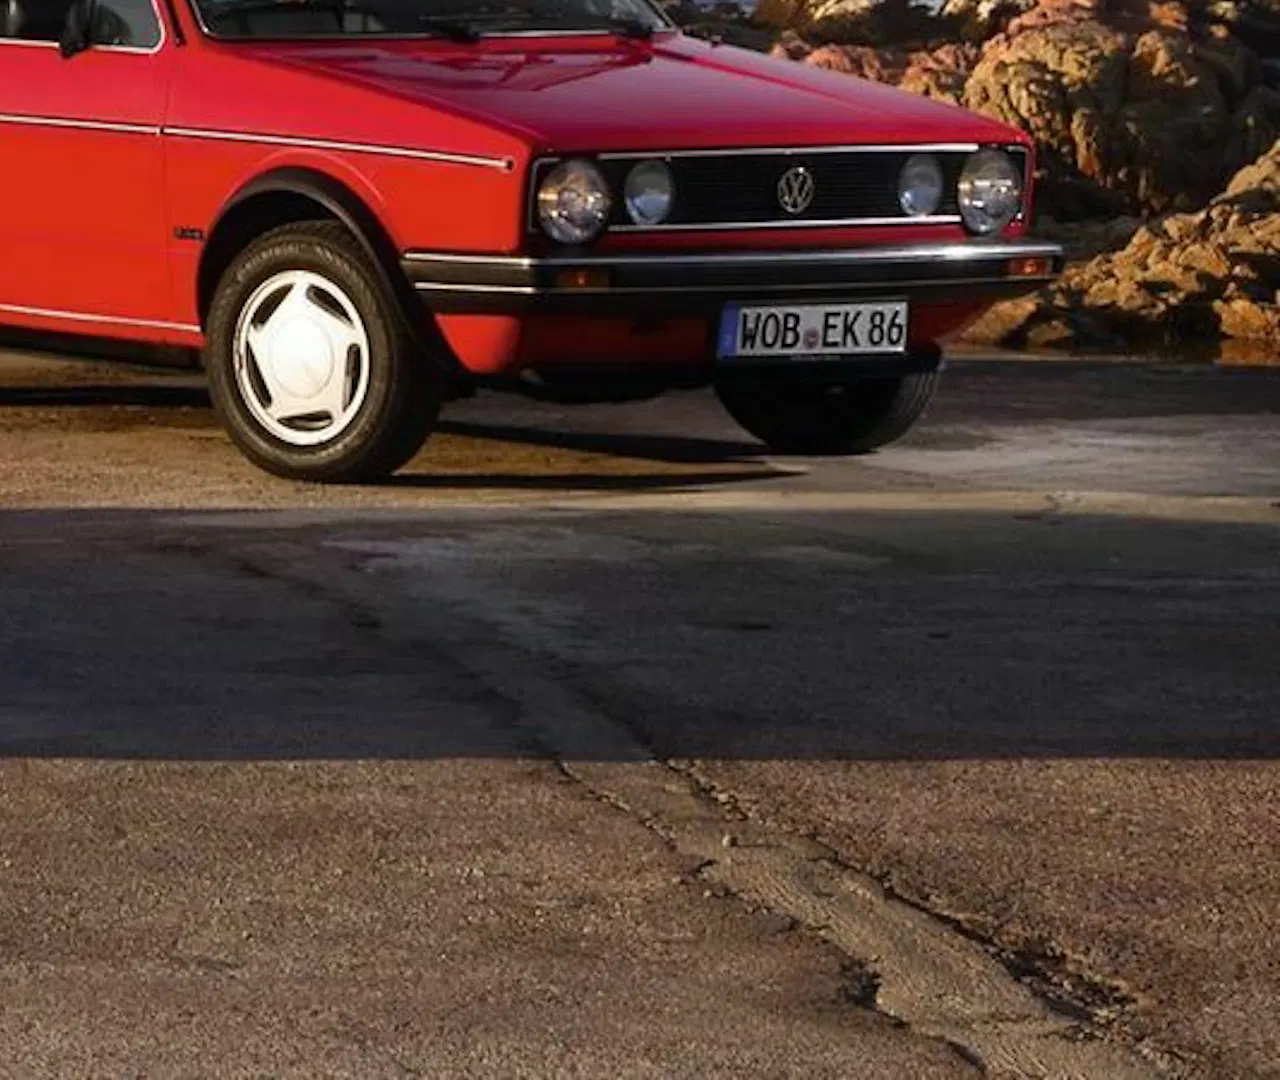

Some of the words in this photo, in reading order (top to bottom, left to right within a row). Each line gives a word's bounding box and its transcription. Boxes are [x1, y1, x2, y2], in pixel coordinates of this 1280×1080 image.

[778, 167, 813, 213] VW
[741, 312, 801, 350] WOB
[821, 310, 863, 348] EK
[868, 309, 904, 347] 86
